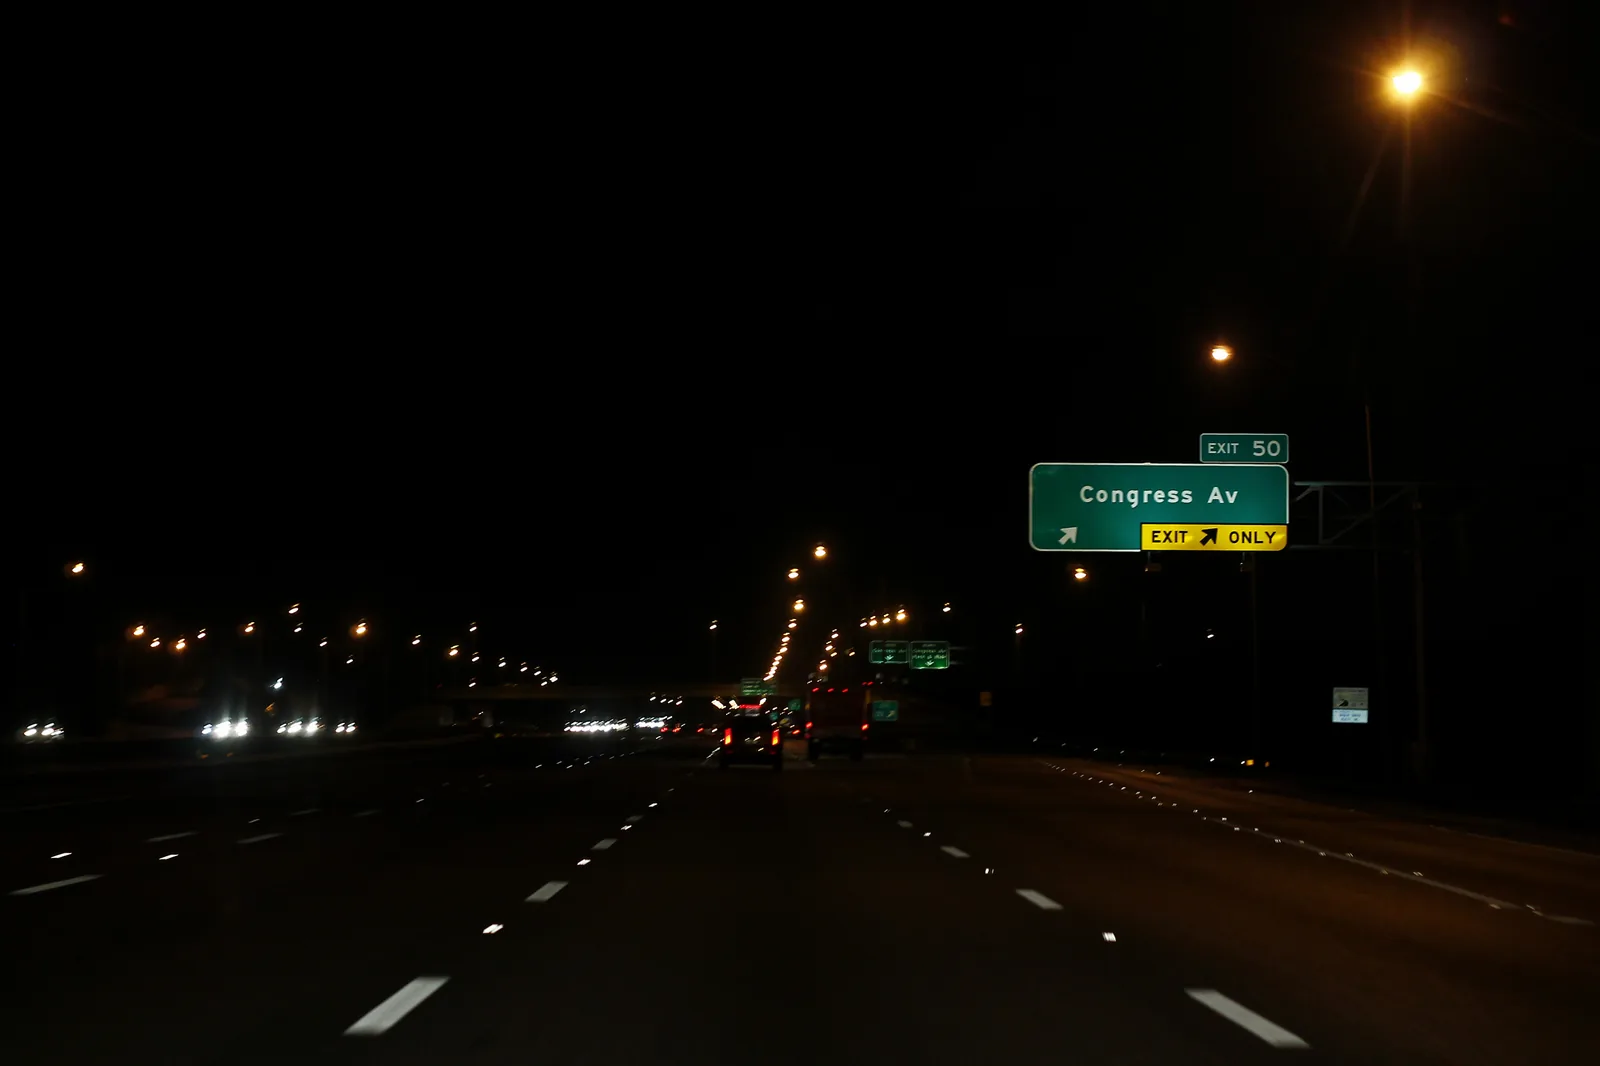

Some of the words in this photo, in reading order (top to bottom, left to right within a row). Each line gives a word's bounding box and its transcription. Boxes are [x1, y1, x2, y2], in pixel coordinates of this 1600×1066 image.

[1208, 443, 1239, 454] EXIT
[1253, 440, 1281, 457] 50
[1079, 485, 1193, 508] Congress
[1207, 486, 1239, 504] Av
[1151, 530, 1189, 544] EXIT
[1229, 530, 1276, 544] ONLY
